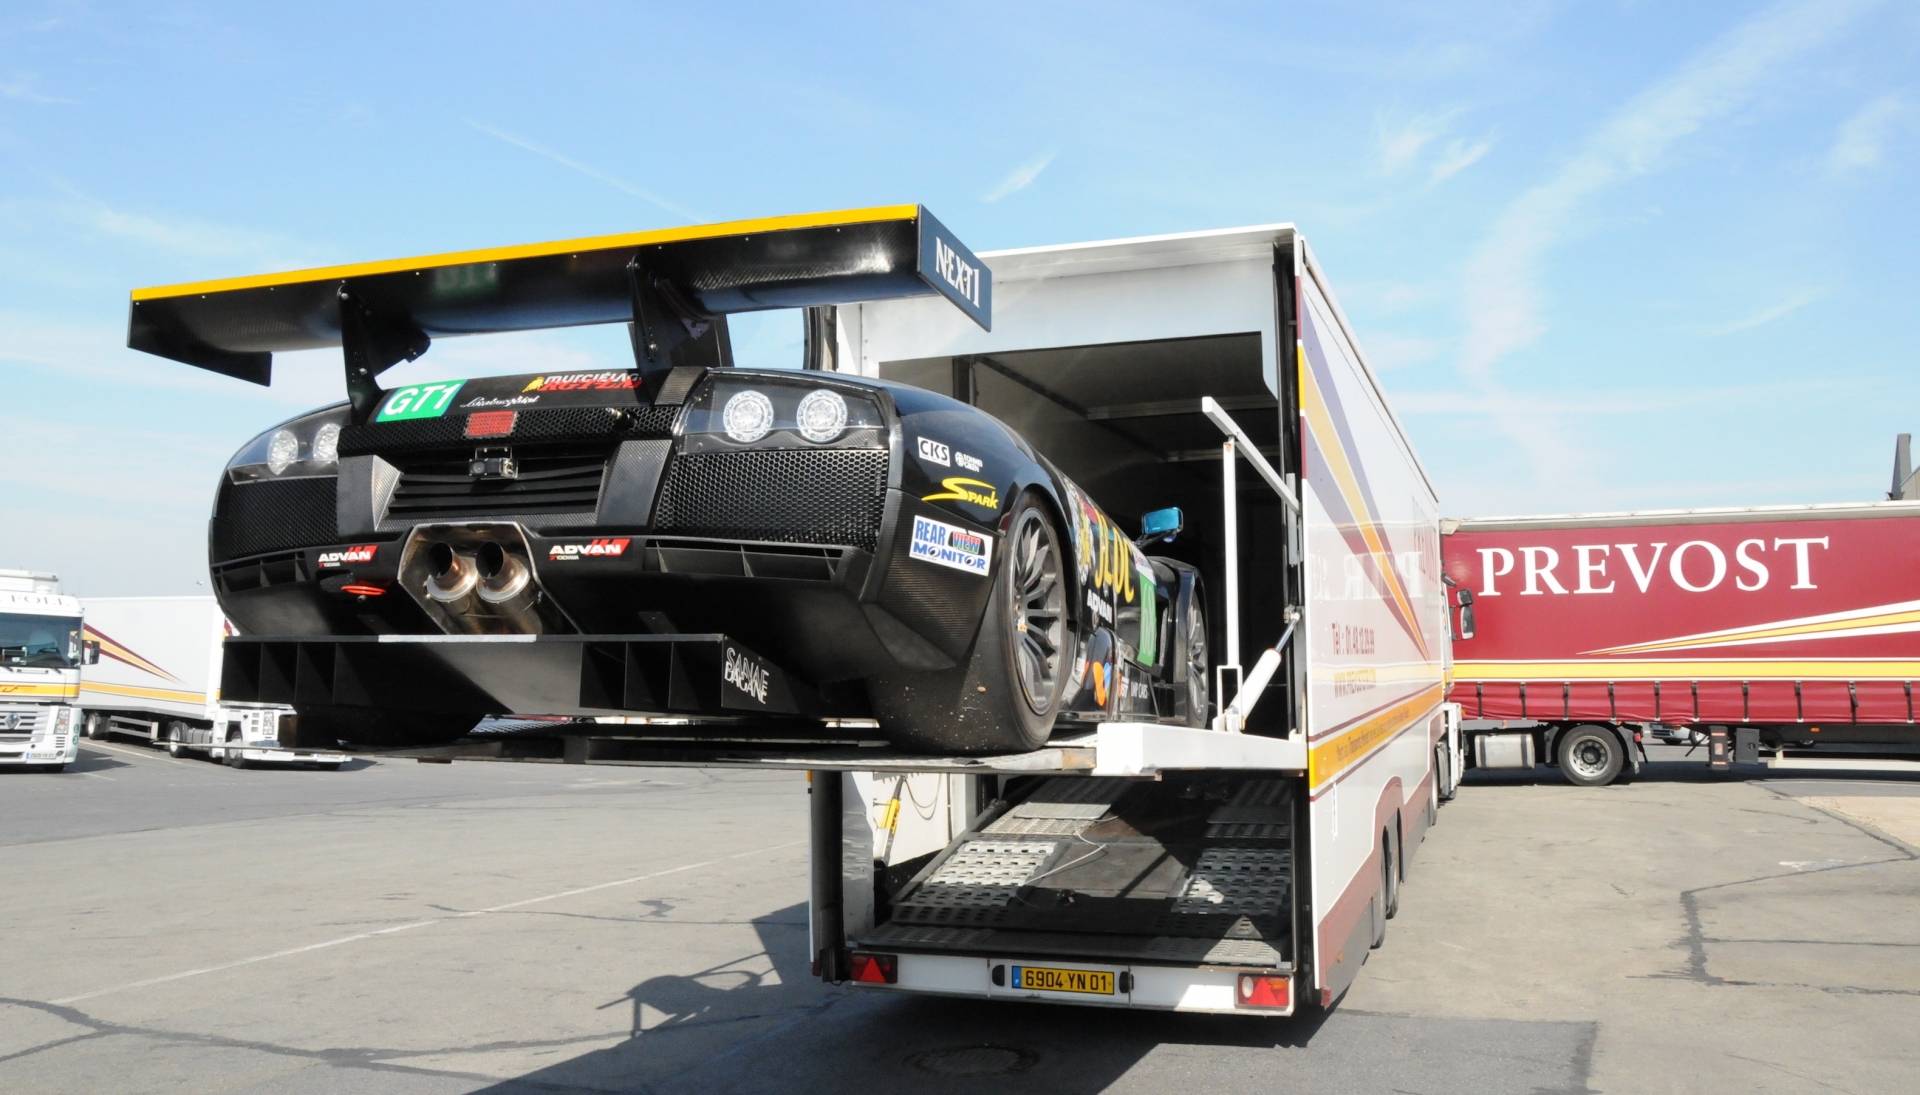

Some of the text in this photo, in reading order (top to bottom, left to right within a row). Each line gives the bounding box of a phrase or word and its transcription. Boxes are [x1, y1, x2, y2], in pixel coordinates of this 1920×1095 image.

[384, 383, 461, 415] GT1
[919, 440, 949, 461] CKS
[915, 519, 981, 555] REAR VIEW
[318, 551, 371, 562] ADVAN
[549, 544, 621, 556] ADVAN
[913, 542, 985, 569] MONITOR
[1476, 535, 1829, 597] PREVOST
[1025, 970, 1107, 991] 6904 YN 01
